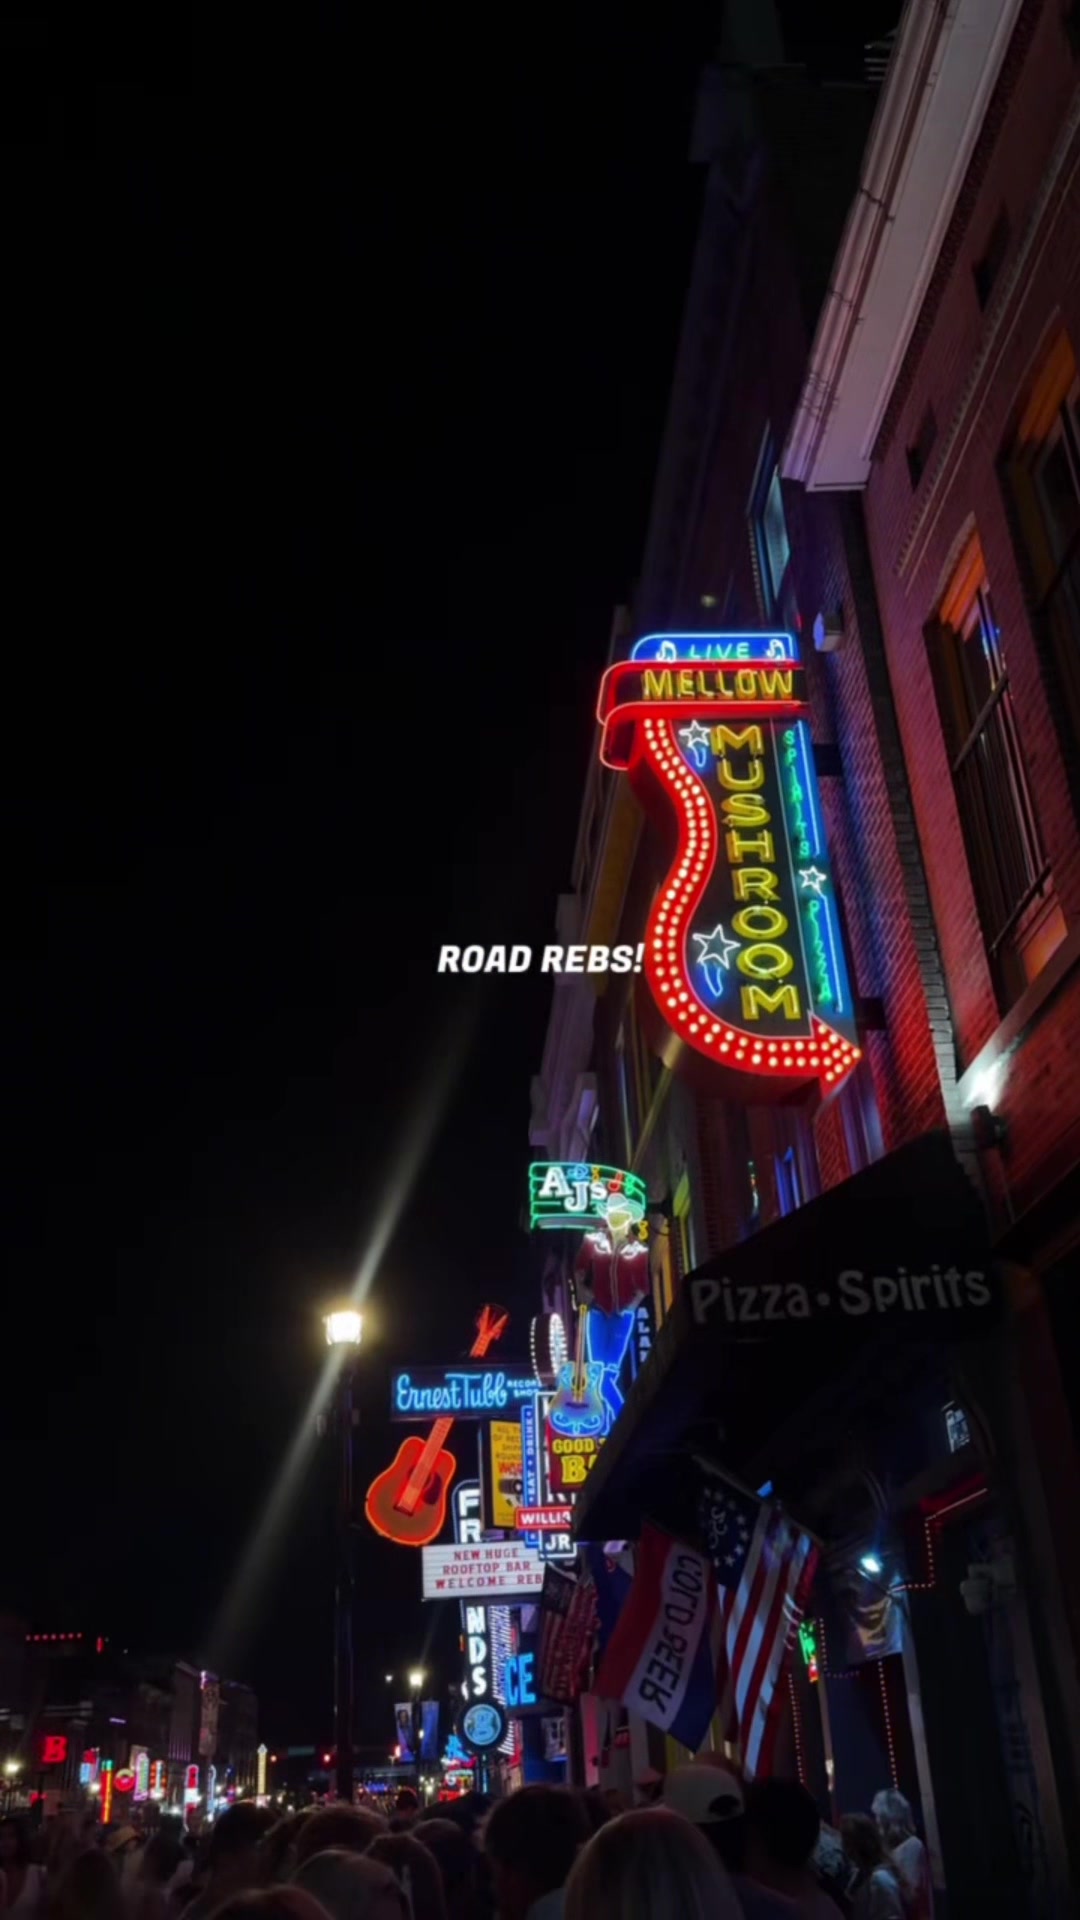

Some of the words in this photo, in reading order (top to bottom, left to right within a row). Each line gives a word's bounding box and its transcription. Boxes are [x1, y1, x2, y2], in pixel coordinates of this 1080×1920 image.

[689, 641, 750, 659] LIVE
[642, 669, 793, 700] MELLOW
[711, 724, 801, 1020] MUSHROOM
[784, 729, 811, 857] SPIRITS
[809, 900, 833, 1003] PIZZA
[689, 1276, 811, 1323] Pizza
[837, 1264, 992, 1316] Spirits
[397, 1374, 462, 1411] Ernest
[445, 1372, 508, 1408] Tubb
[552, 1438, 595, 1455] GOOD
[527, 1471, 535, 1495] EAT
[545, 1534, 571, 1551] JR
[454, 1550, 480, 1561] NEW
[485, 1548, 519, 1560] HUGE
[443, 1563, 501, 1576] ROOFTOP
[506, 1561, 531, 1572] BAR
[435, 1576, 506, 1589] WELCOME
